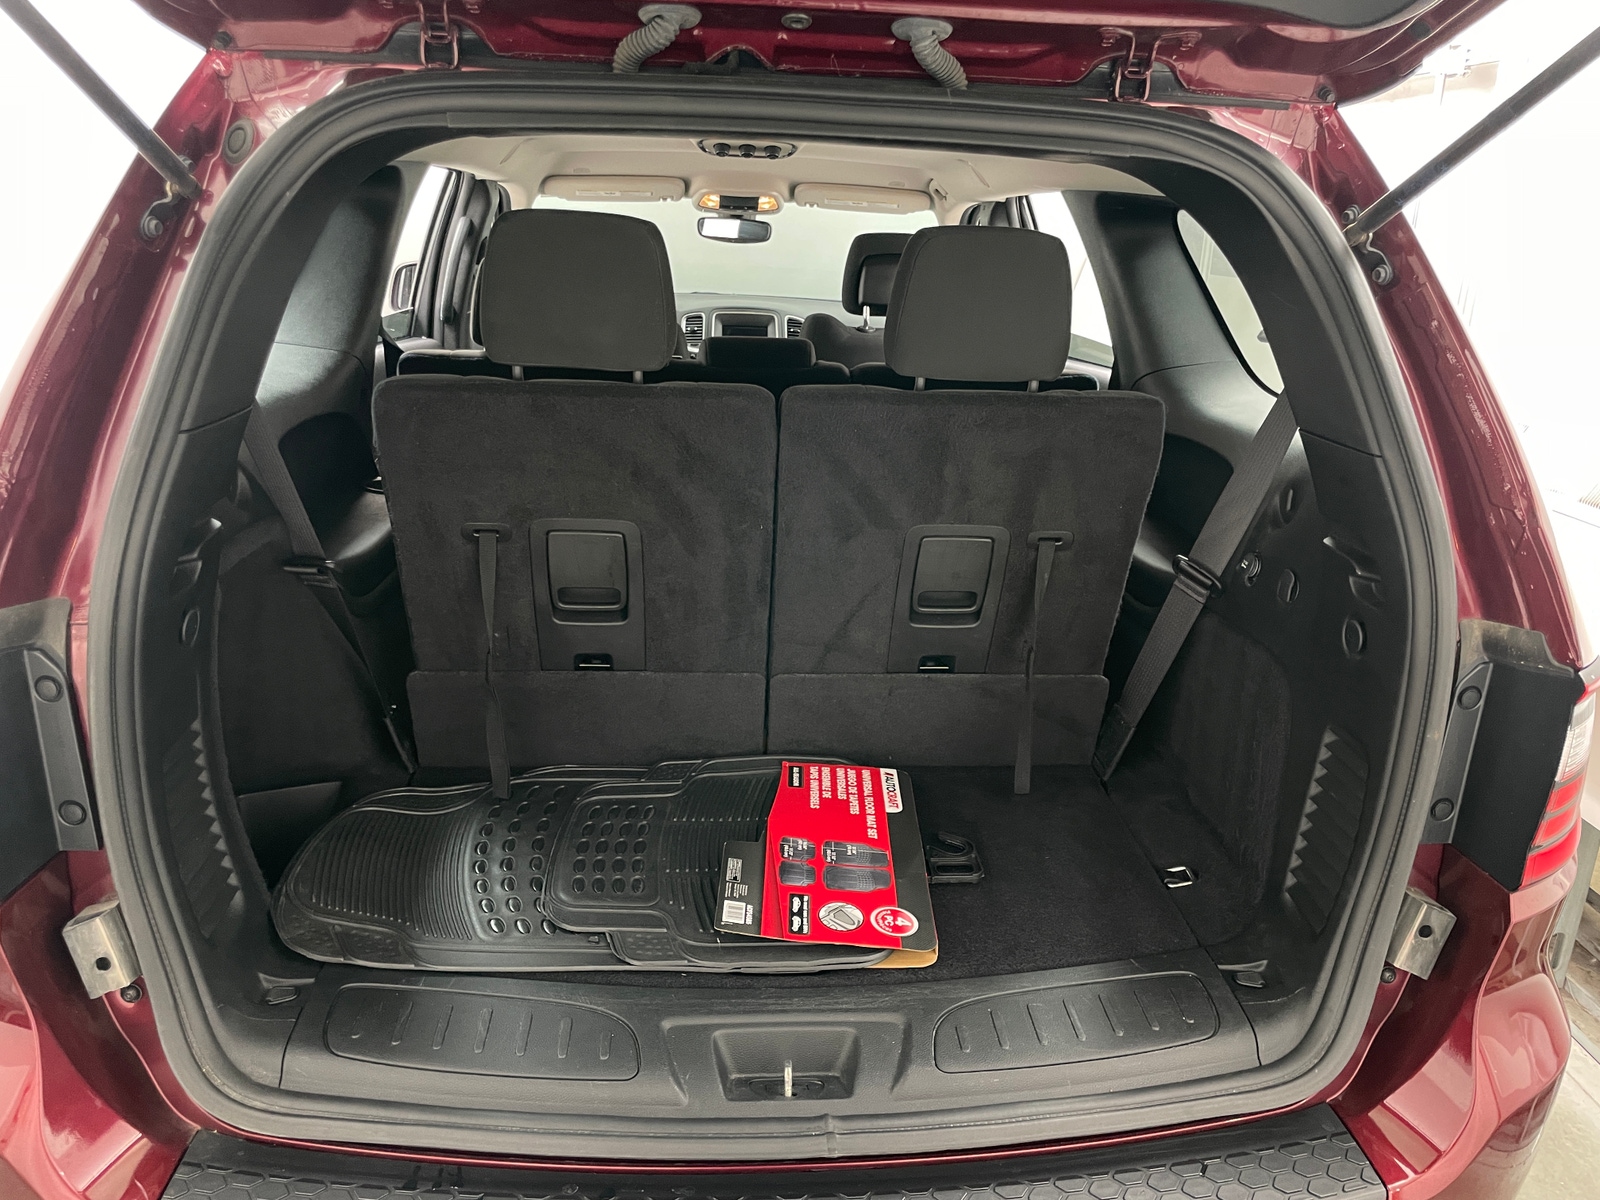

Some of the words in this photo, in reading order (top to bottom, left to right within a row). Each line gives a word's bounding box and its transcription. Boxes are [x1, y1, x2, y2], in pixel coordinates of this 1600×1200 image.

[810, 766, 819, 779] TAPIS
[822, 767, 831, 791] ENSEMBLE
[847, 769, 857, 786] JUEGO
[836, 768, 847, 800] UNIVERSALES
[848, 787, 858, 795] DE
[862, 770, 873, 796] UNIVERSAL
[810, 780, 820, 809] UNIVERSELS
[886, 776, 898, 808] AUTOCRAFT
[850, 795, 859, 814] TAPETES
[865, 796, 876, 814] FLOOR
[867, 815, 876, 828] MAT
[867, 828, 878, 839] SET
[884, 915, 894, 926] PC
[895, 917, 912, 926] 4
